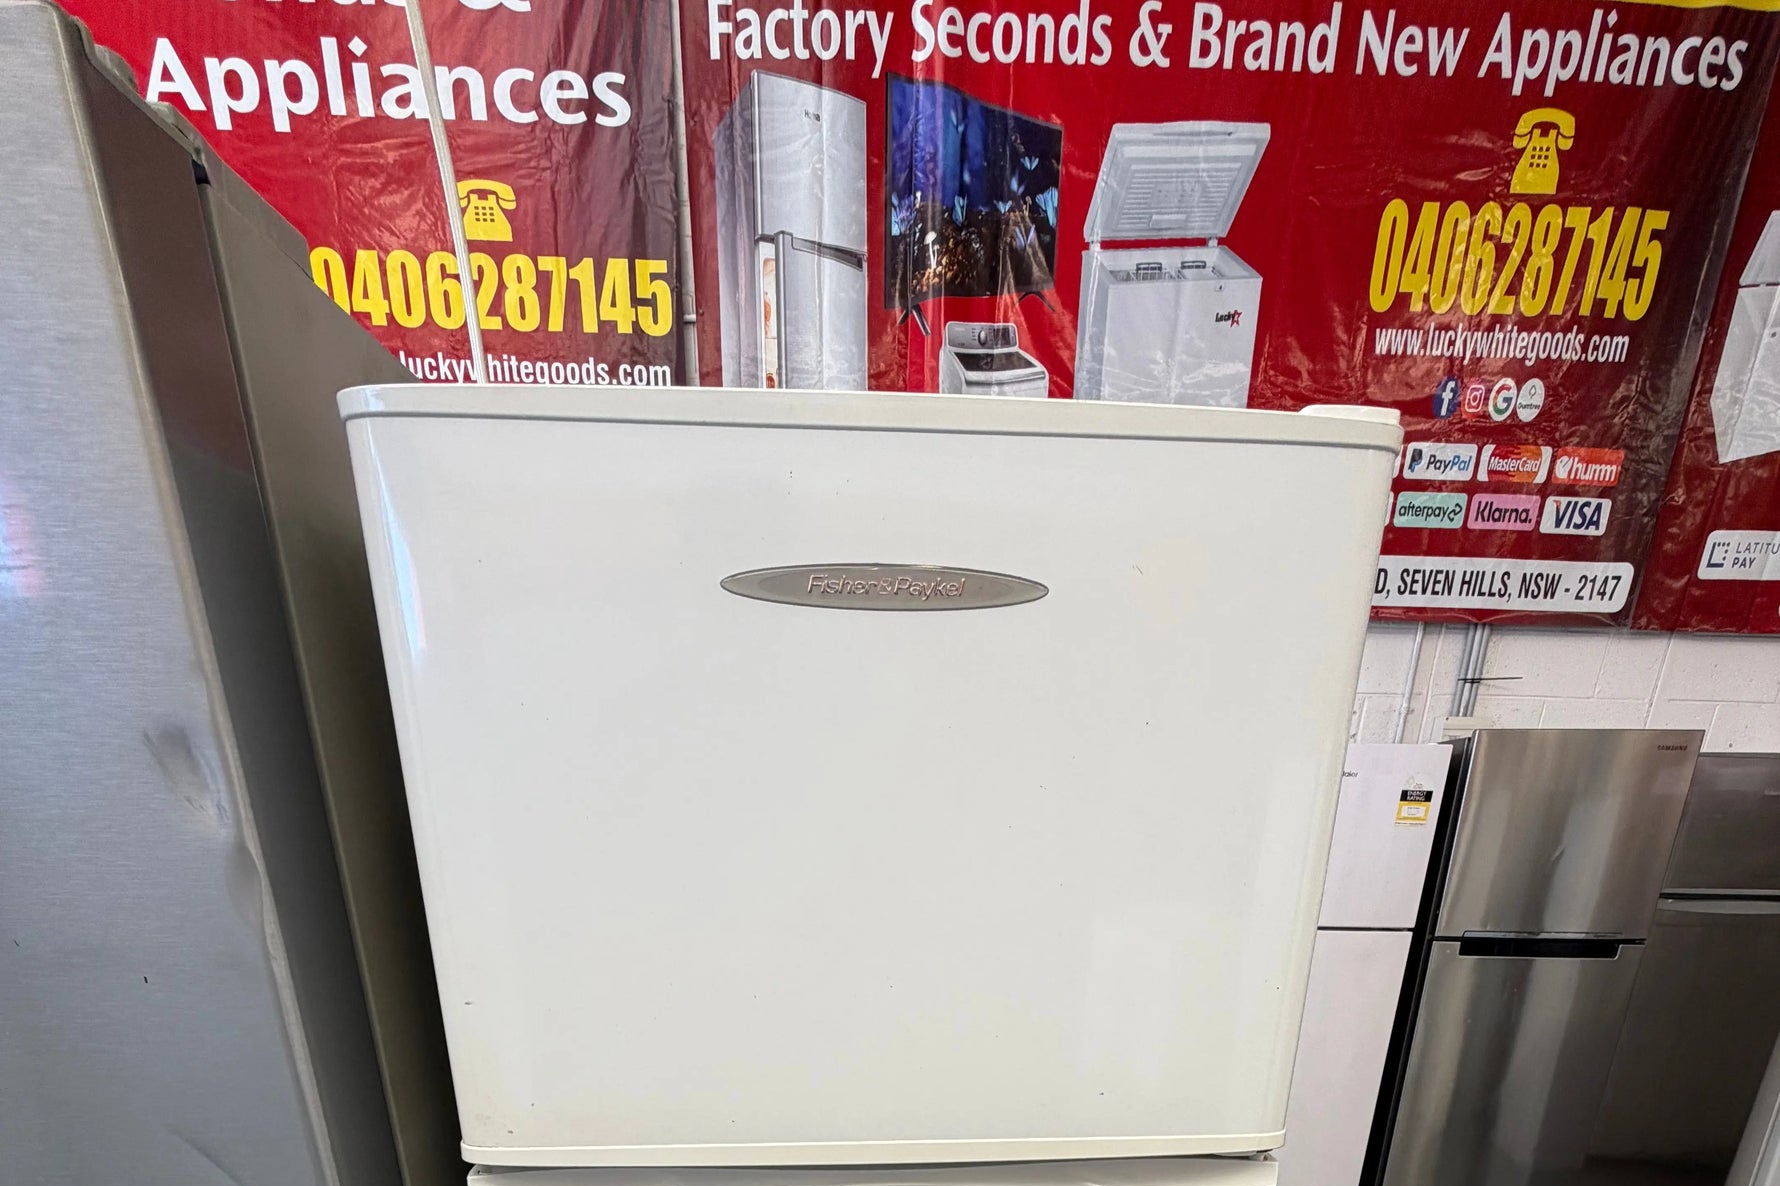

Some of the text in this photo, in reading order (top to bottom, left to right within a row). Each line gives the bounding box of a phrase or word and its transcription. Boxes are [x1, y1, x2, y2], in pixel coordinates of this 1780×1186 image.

[707, 0, 1749, 97] Factory Seconds & Brand New Appliances
[145, 36, 632, 133] Appliances
[1369, 198, 1670, 320] 0406287145
[1375, 324, 1629, 366] www.luckywhitegoods.com
[1426, 454, 1472, 474] PayPal
[1488, 456, 1541, 472] MasterCard
[1570, 456, 1617, 481] humm
[1398, 501, 1449, 521] afterpay
[1552, 500, 1603, 531] VISA
[1731, 557, 1757, 568] PAY
[1397, 568, 1456, 596] SEVEN
[1458, 570, 1512, 602] HILLS,
[1518, 572, 1562, 599] NSW
[1575, 574, 1622, 601] 2147
